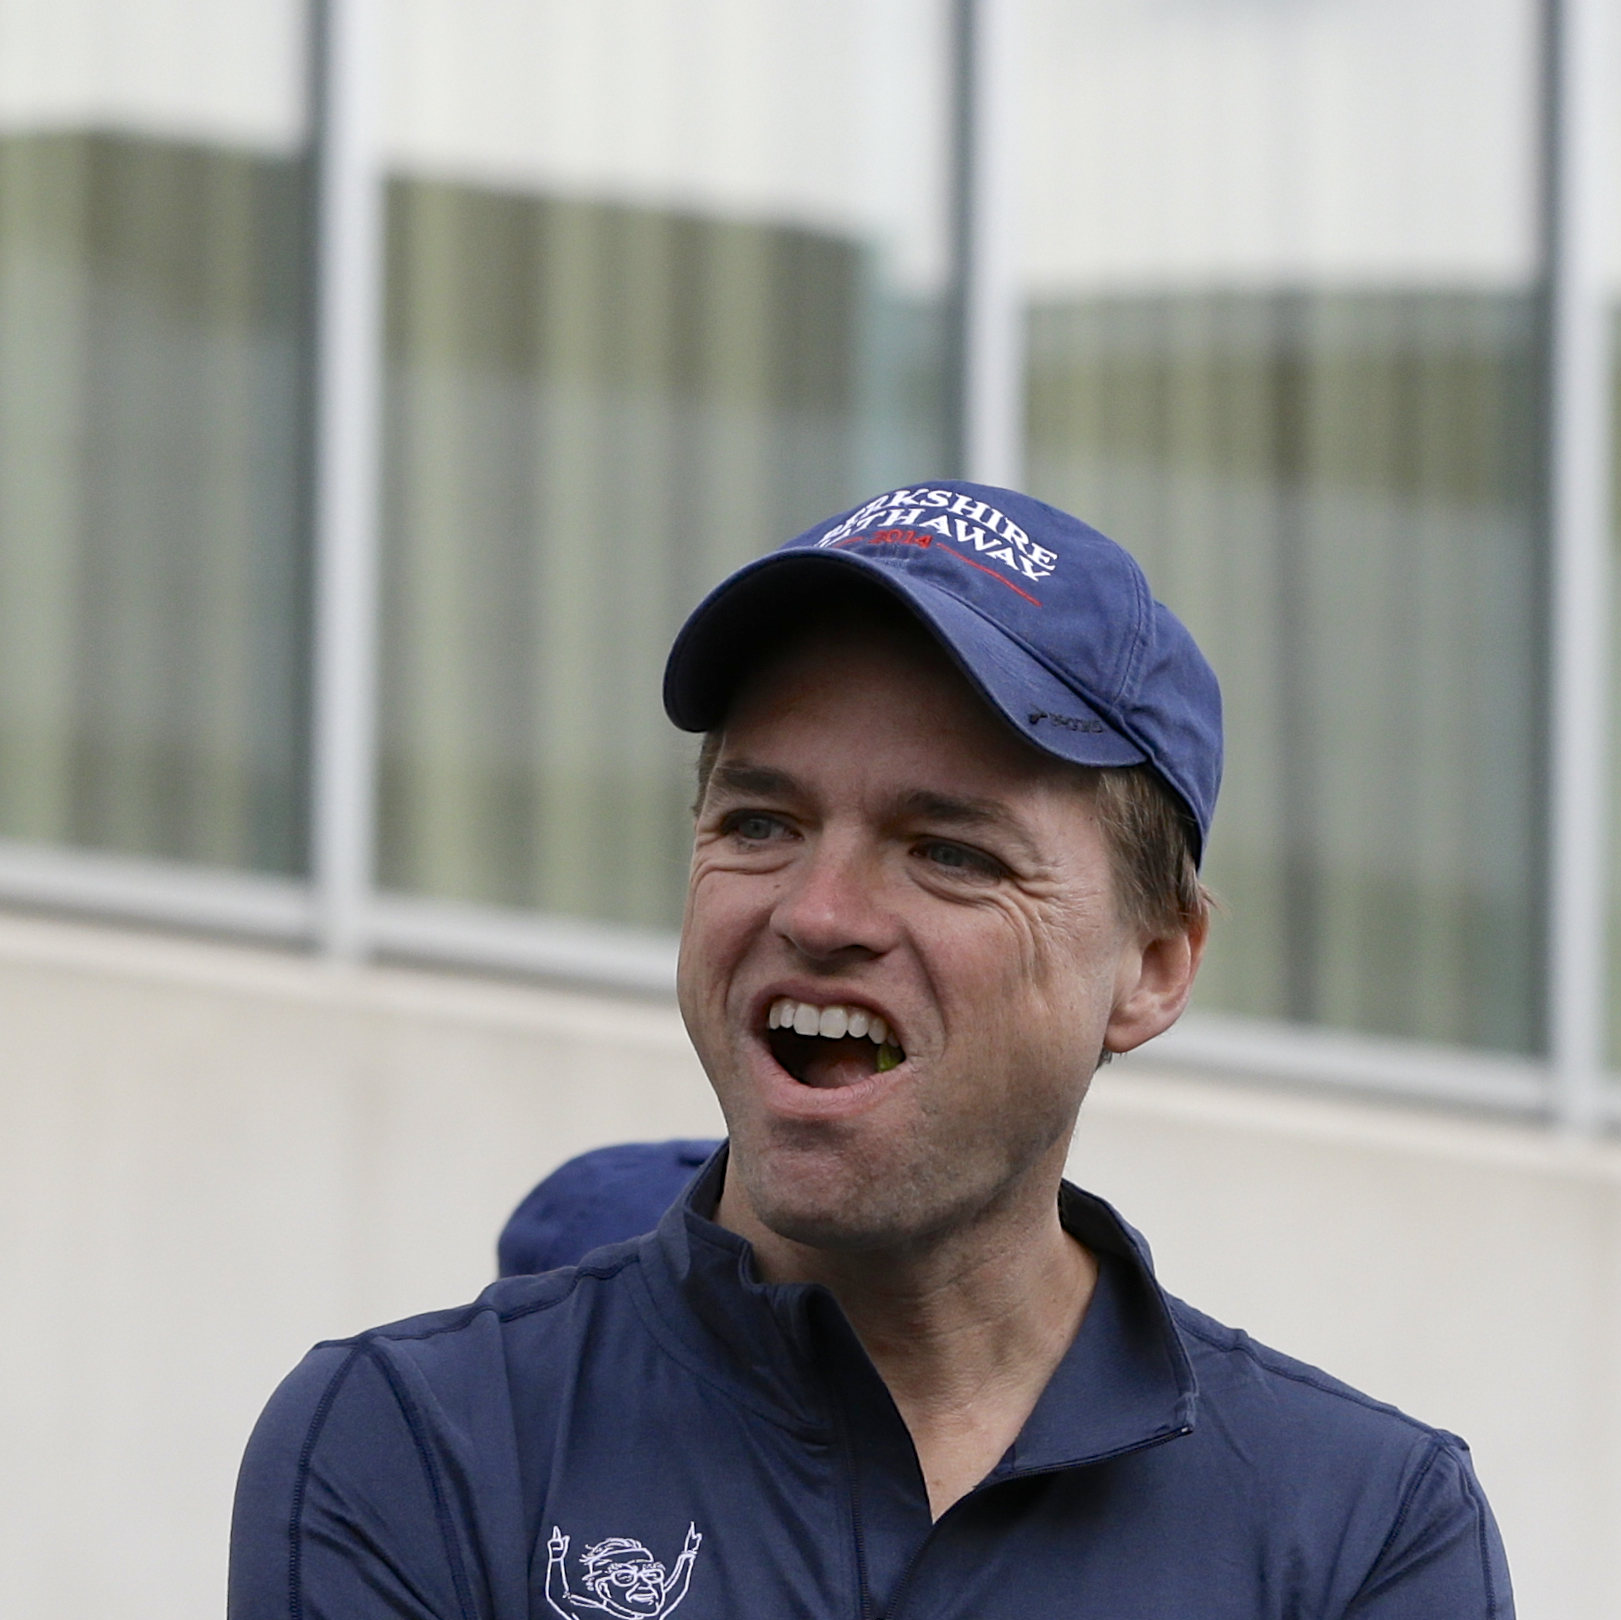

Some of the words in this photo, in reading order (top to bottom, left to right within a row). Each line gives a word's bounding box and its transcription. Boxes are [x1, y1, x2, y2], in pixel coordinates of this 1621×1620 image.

[812, 488, 1058, 571] BERKSHIRE
[822, 507, 1051, 582] ATHAWAY
[868, 528, 933, 549] 2014
